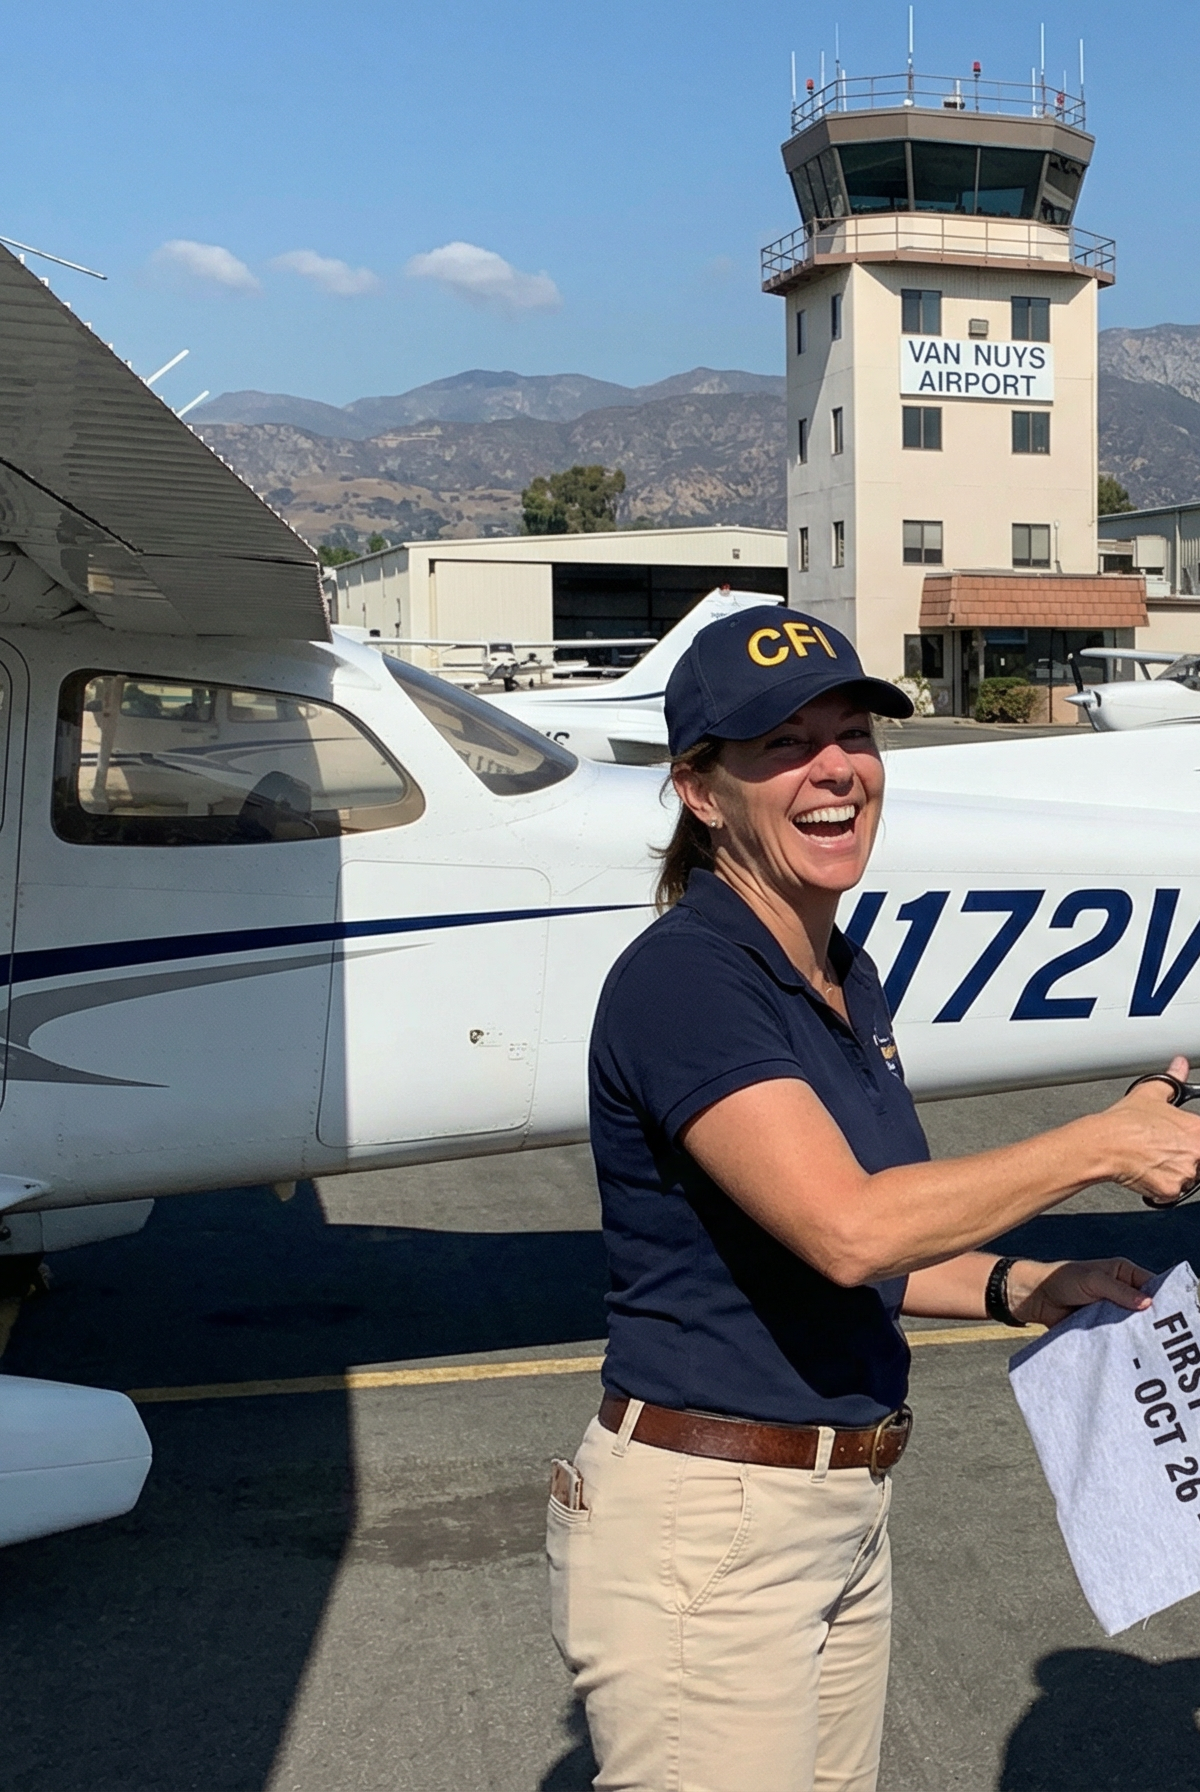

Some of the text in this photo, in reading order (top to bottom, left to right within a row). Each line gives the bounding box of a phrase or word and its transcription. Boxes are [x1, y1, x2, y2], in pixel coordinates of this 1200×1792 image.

[908, 340, 1046, 369] VAN NUYS
[918, 370, 1037, 396] AIRPORT
[748, 620, 838, 668] CFI
[1134, 1378, 1187, 1446] OCT
